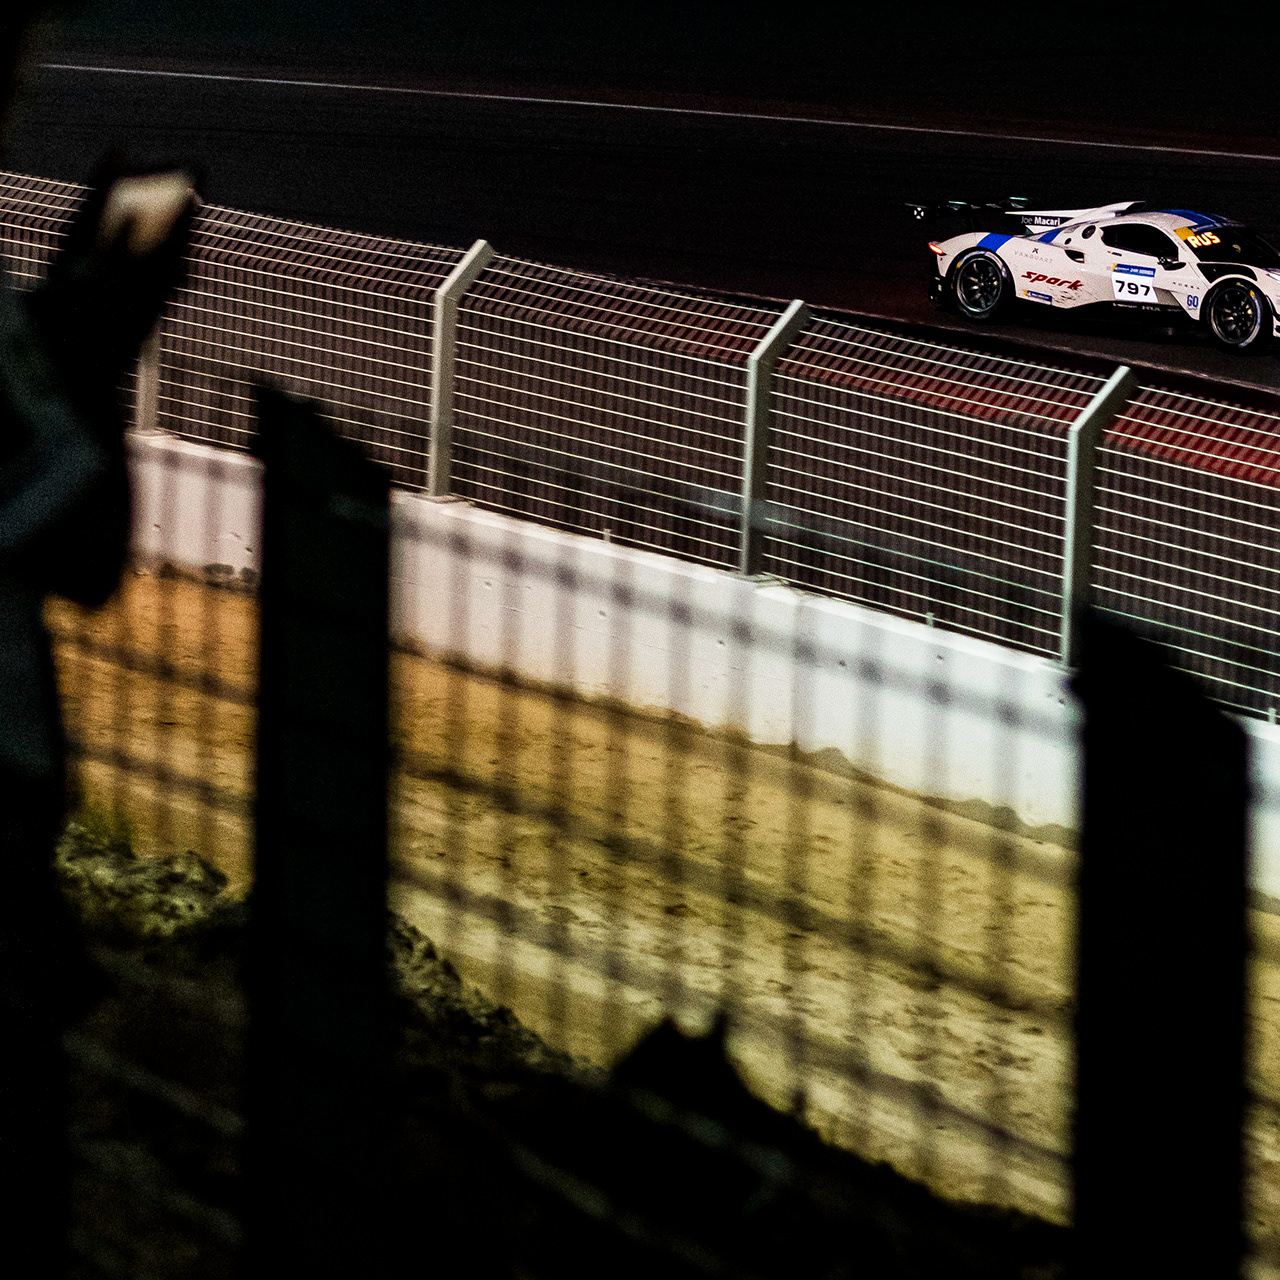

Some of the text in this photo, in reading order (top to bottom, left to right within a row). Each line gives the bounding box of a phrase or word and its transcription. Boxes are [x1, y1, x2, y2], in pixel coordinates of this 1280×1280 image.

[1034, 216, 1061, 226] Macari
[1187, 231, 1221, 248] RUS
[1115, 279, 1151, 297] 797
